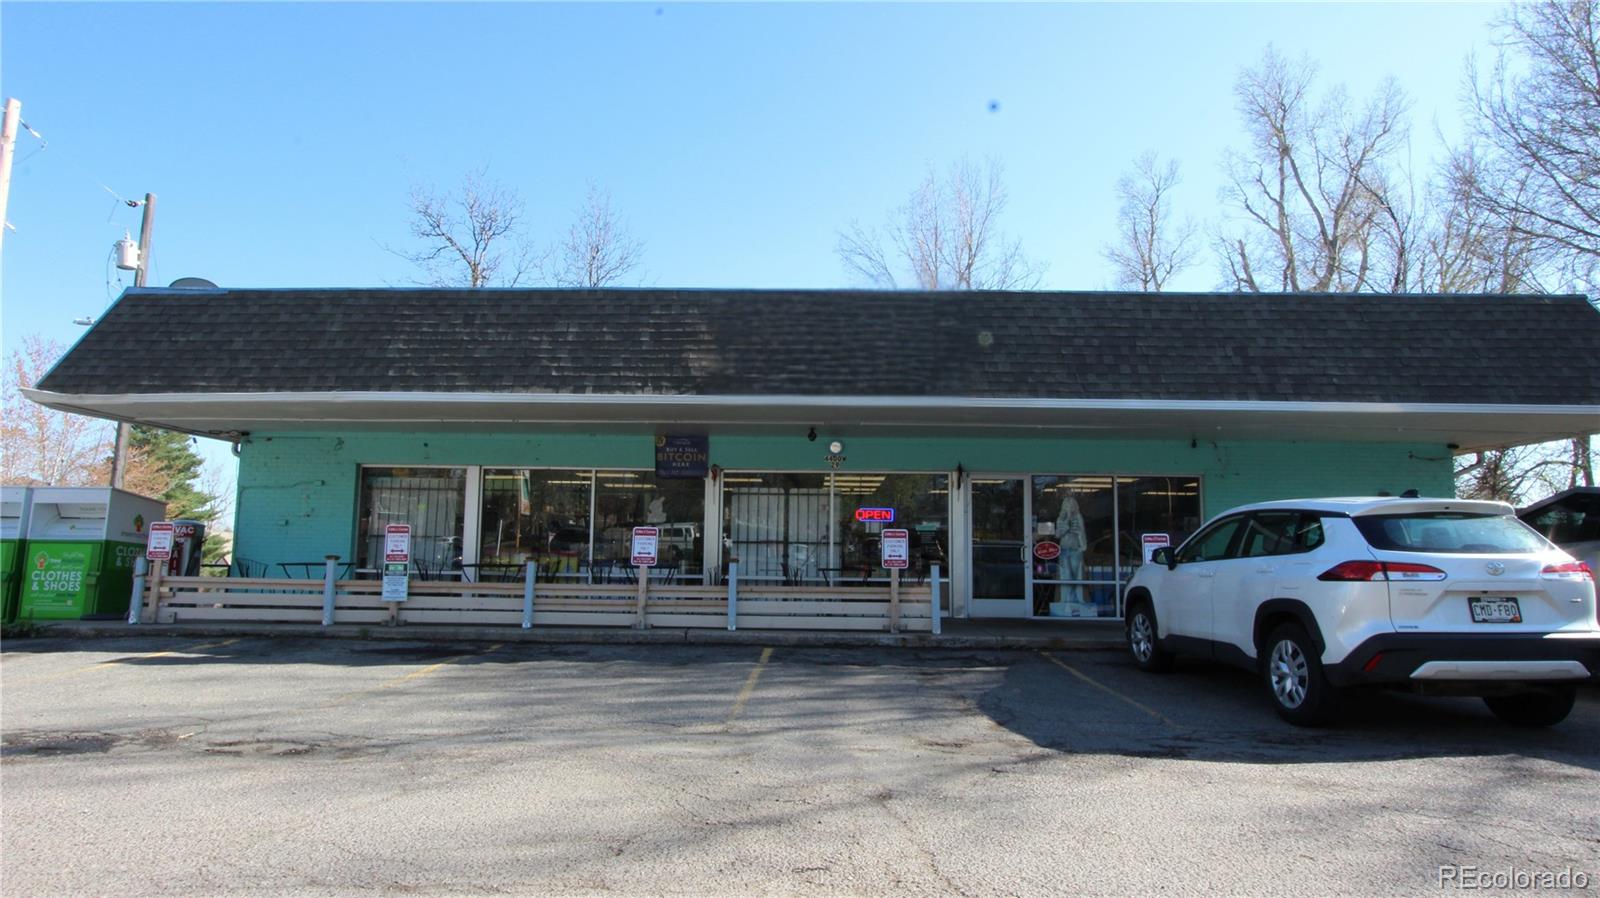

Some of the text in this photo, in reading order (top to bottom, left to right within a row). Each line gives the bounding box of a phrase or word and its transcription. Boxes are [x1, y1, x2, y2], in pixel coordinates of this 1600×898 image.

[657, 452, 706, 462] BITCOIN
[856, 510, 891, 519] OPEN
[175, 526, 195, 534] VAC
[32, 570, 82, 581] CLOTHES
[32, 581, 81, 591] & SHOES
